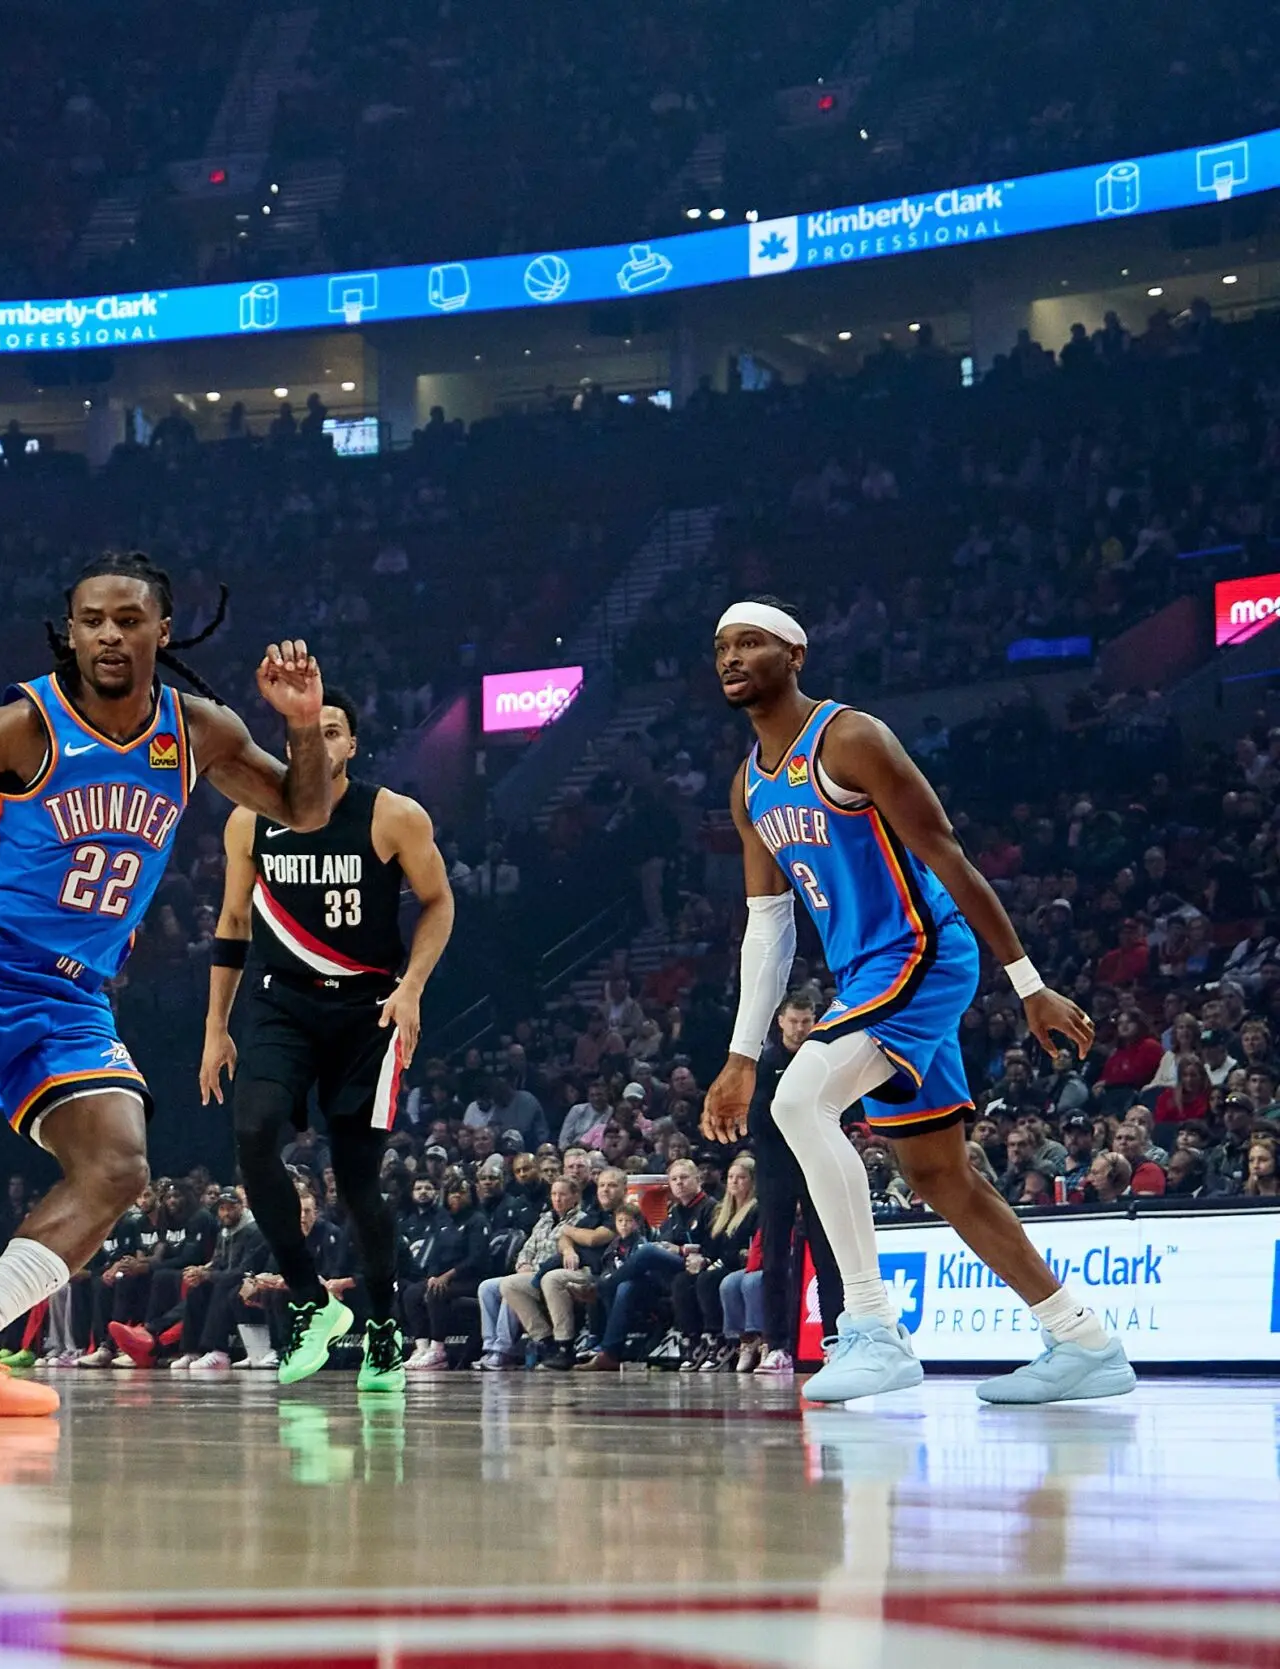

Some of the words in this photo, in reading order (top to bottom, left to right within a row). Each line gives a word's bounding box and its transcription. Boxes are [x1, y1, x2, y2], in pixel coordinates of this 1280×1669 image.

[807, 218, 1003, 263] PROFESSIONAL
[45, 784, 179, 850] THUNDER
[754, 806, 829, 856] HUNDER
[60, 844, 142, 916] 22
[261, 853, 362, 884] PORTLAND
[791, 862, 830, 909] 2
[324, 888, 362, 928] 33
[934, 1305, 1161, 1332] PROFESNAL
